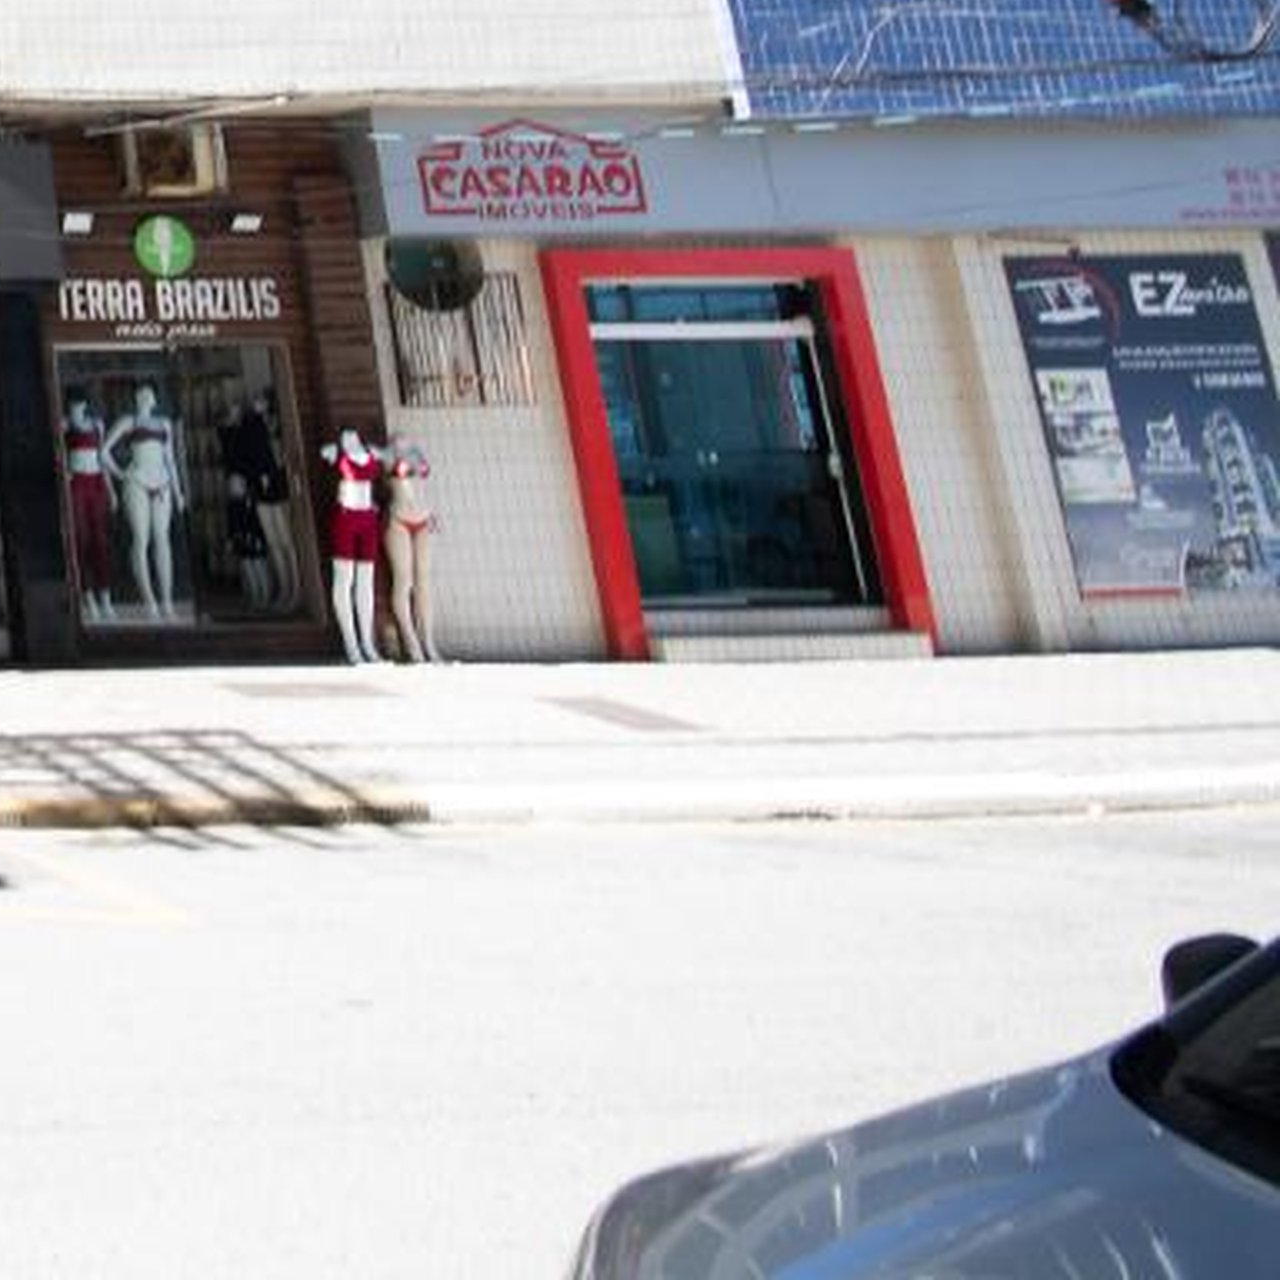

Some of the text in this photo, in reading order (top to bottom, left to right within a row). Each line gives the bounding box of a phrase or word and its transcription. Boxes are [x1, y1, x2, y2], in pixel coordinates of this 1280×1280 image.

[58, 277, 282, 323] TERRA BRAZILIS
[1129, 271, 1196, 317] EZ
